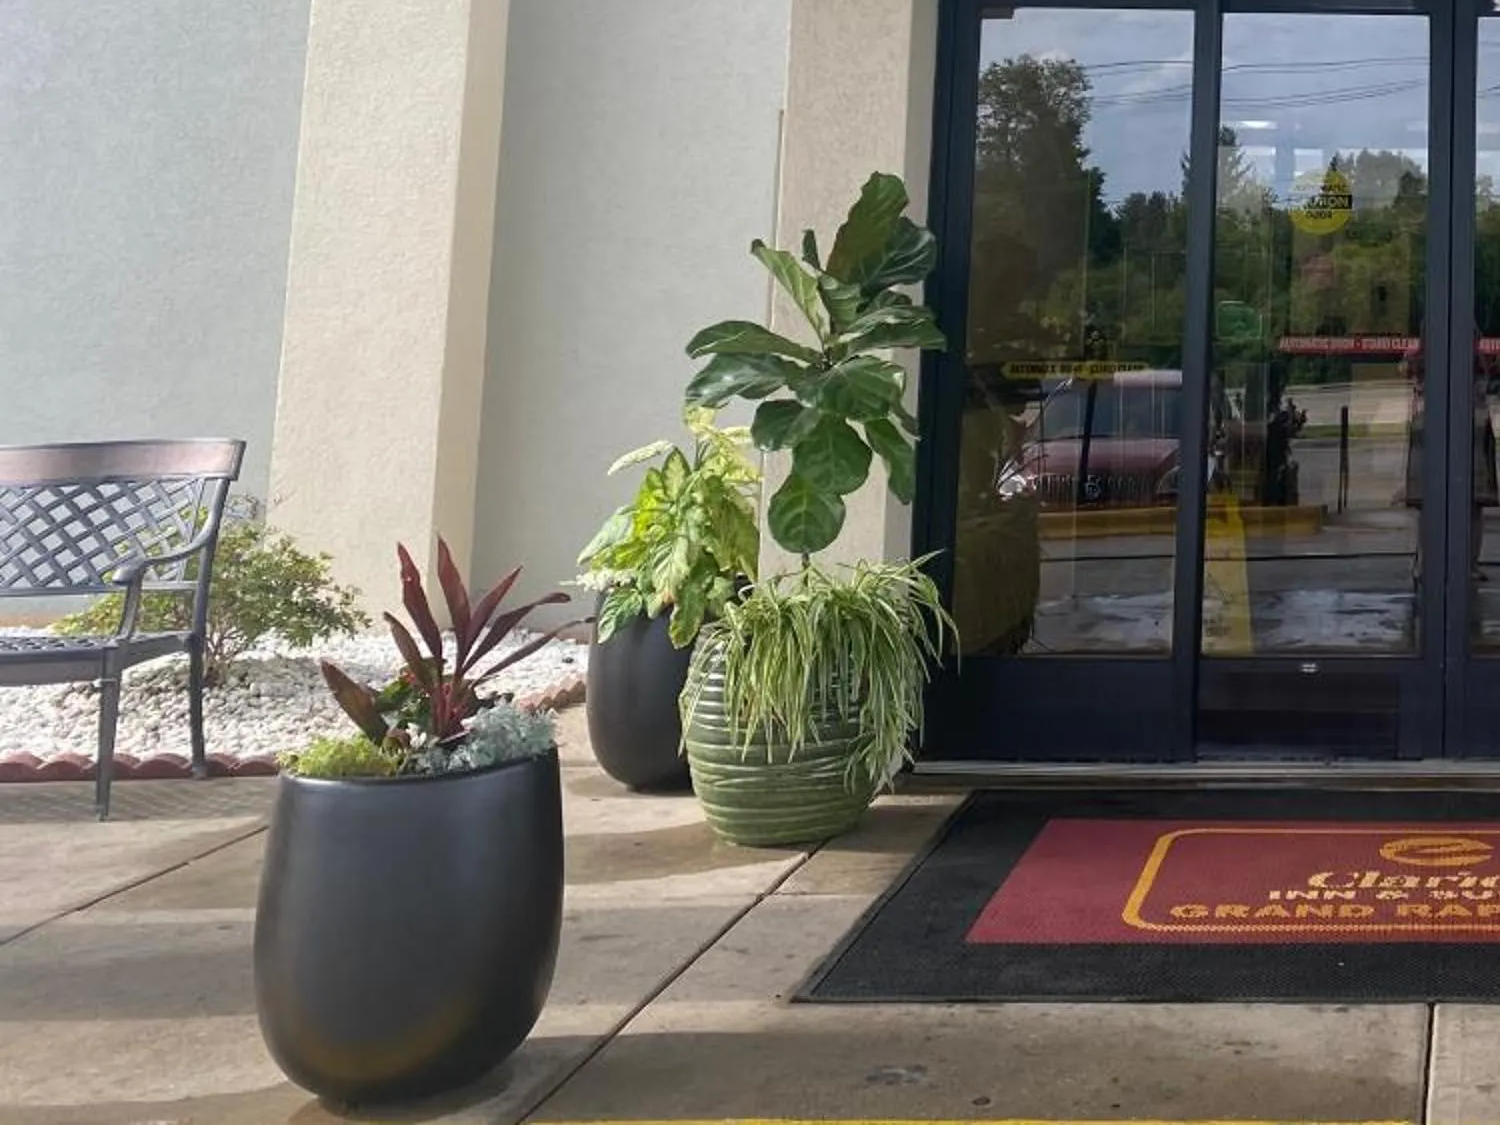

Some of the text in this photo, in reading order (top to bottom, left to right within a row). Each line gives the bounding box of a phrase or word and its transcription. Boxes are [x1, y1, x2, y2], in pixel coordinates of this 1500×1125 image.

[1392, 338, 1420, 349] CLEAR
[1269, 890, 1357, 900] INN
[1375, 890, 1409, 900] &
[1169, 904, 1375, 918] GRAND
